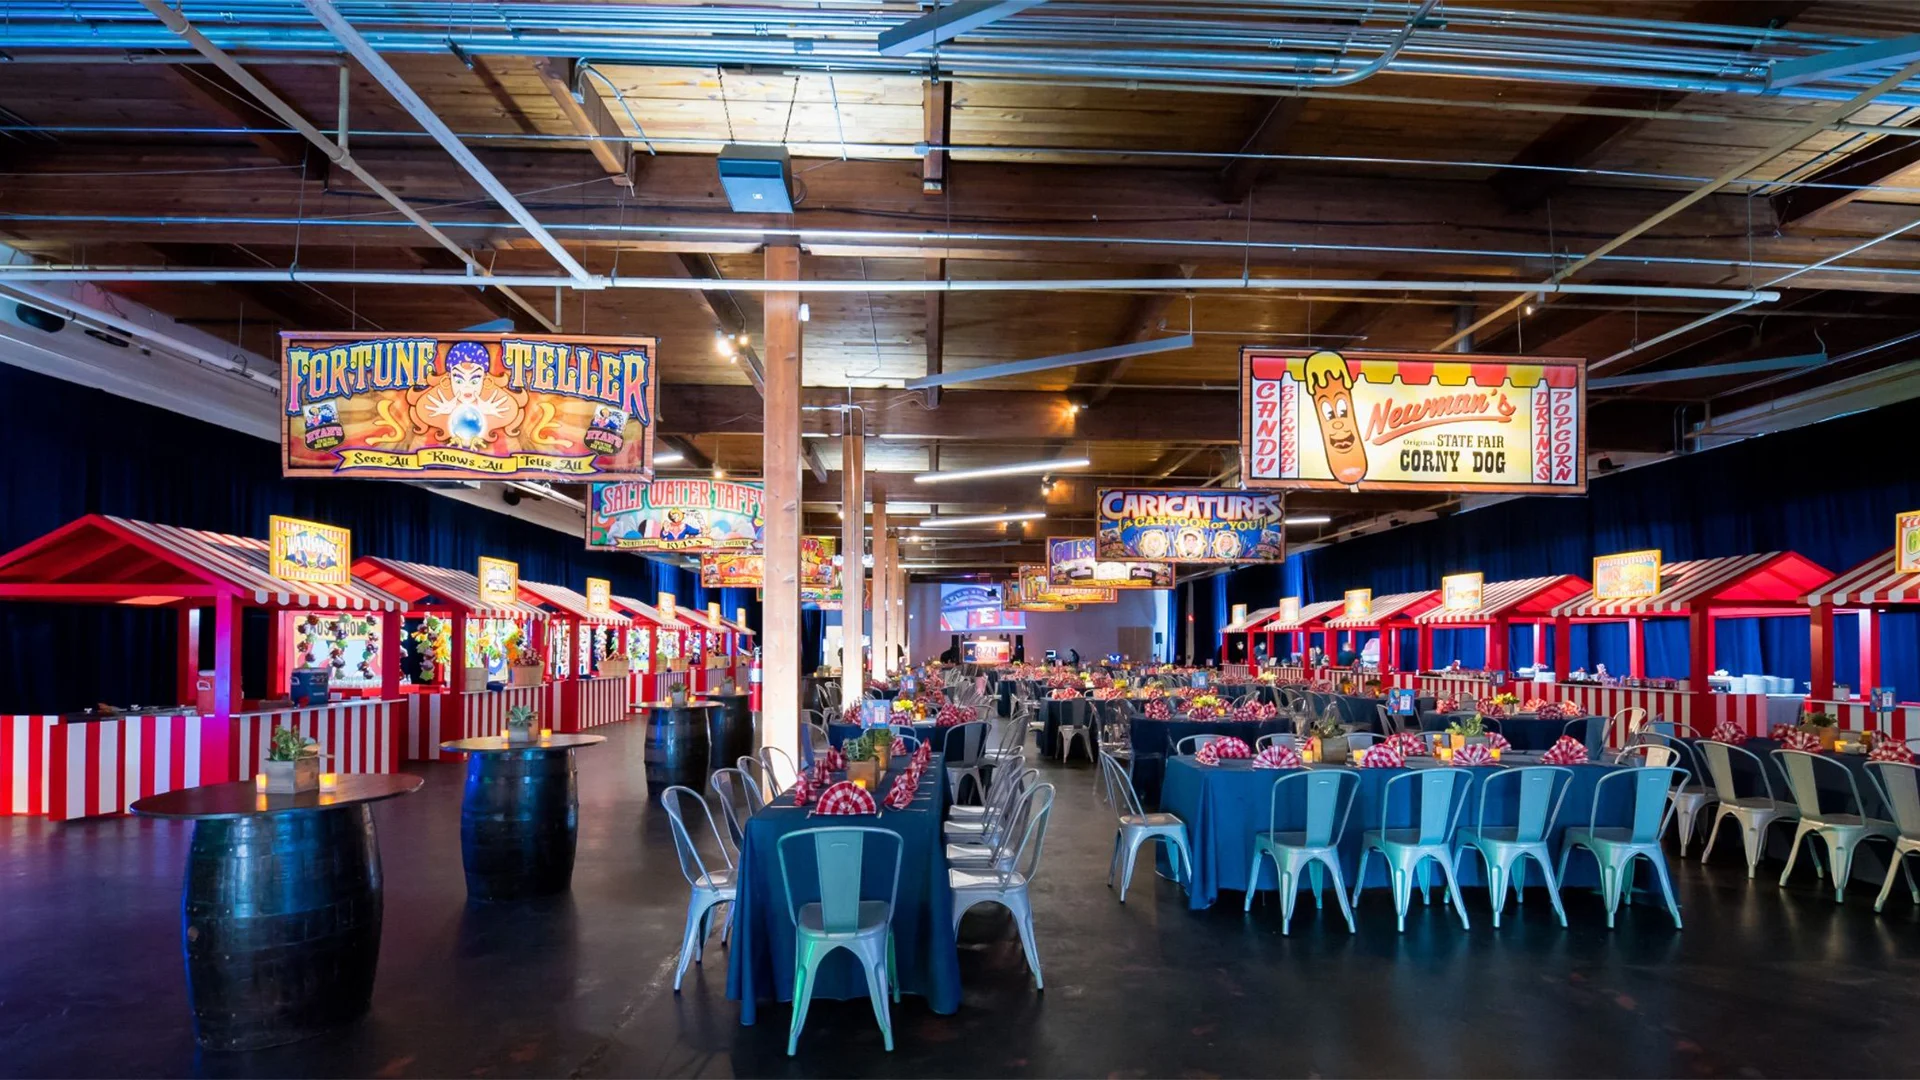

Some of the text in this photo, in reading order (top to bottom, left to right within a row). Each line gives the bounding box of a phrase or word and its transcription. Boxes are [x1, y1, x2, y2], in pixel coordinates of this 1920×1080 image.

[288, 340, 649, 422] FORTUNE TELLER
[1256, 382, 1278, 475] CANDY
[1281, 385, 1295, 433] COTTON
[1364, 388, 1517, 442] Newman's
[1403, 434, 1505, 449] Original STATE FAIR
[1535, 391, 1551, 481] DRINKS
[1553, 391, 1572, 481] POPCORN
[353, 451, 583, 471] Sees All Knows All Tells All
[1400, 449, 1507, 474] CORNY DOG
[603, 481, 646, 513] SALT
[650, 480, 711, 507] WATER
[1101, 492, 1282, 524] CARICATURES
[1134, 515, 1210, 529] CARTOON
